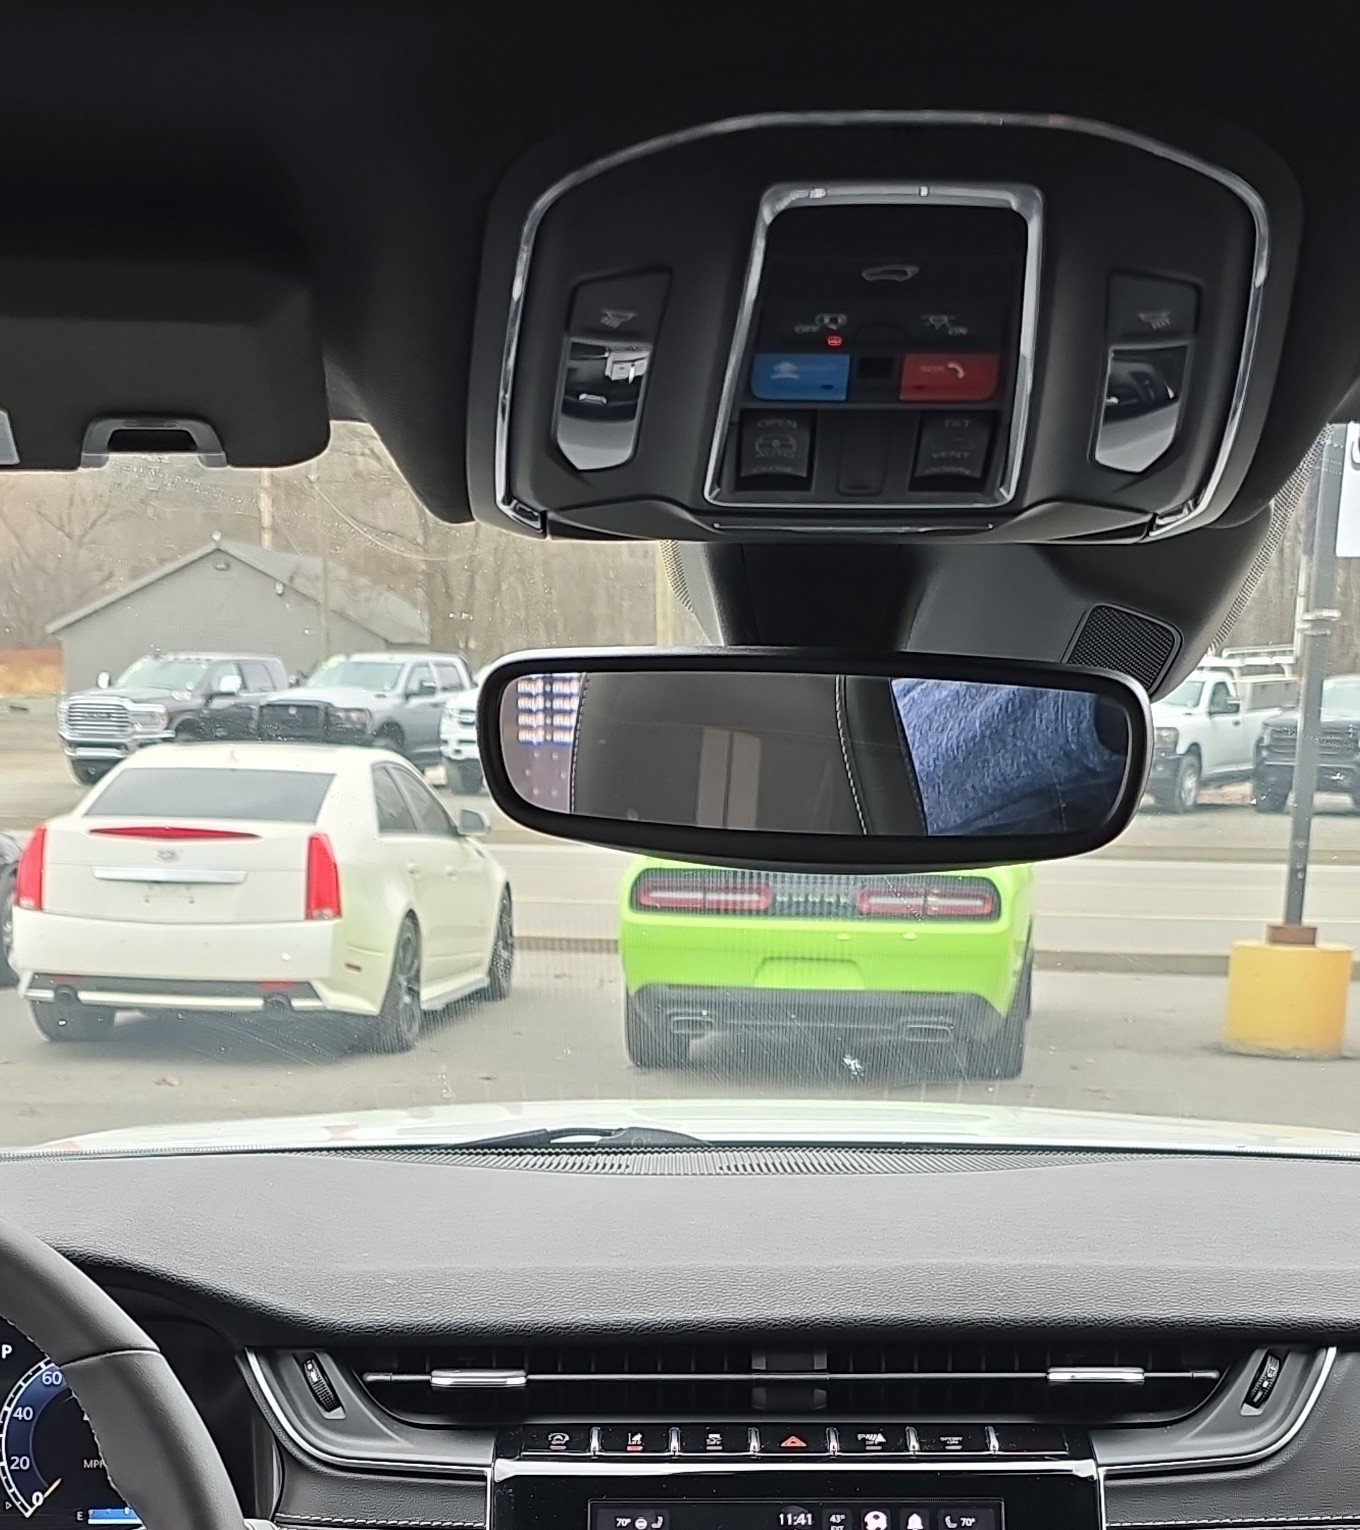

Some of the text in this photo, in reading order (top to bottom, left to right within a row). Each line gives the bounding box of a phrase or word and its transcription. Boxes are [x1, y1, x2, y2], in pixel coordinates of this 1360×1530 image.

[1, 1345, 12, 1359] P
[42, 1371, 62, 1385] 60
[13, 1406, 34, 1421] 40
[10, 1456, 30, 1470] 20
[31, 1491, 44, 1507] 0
[77, 1512, 84, 1521] E
[778, 1513, 813, 1527] 11:41
